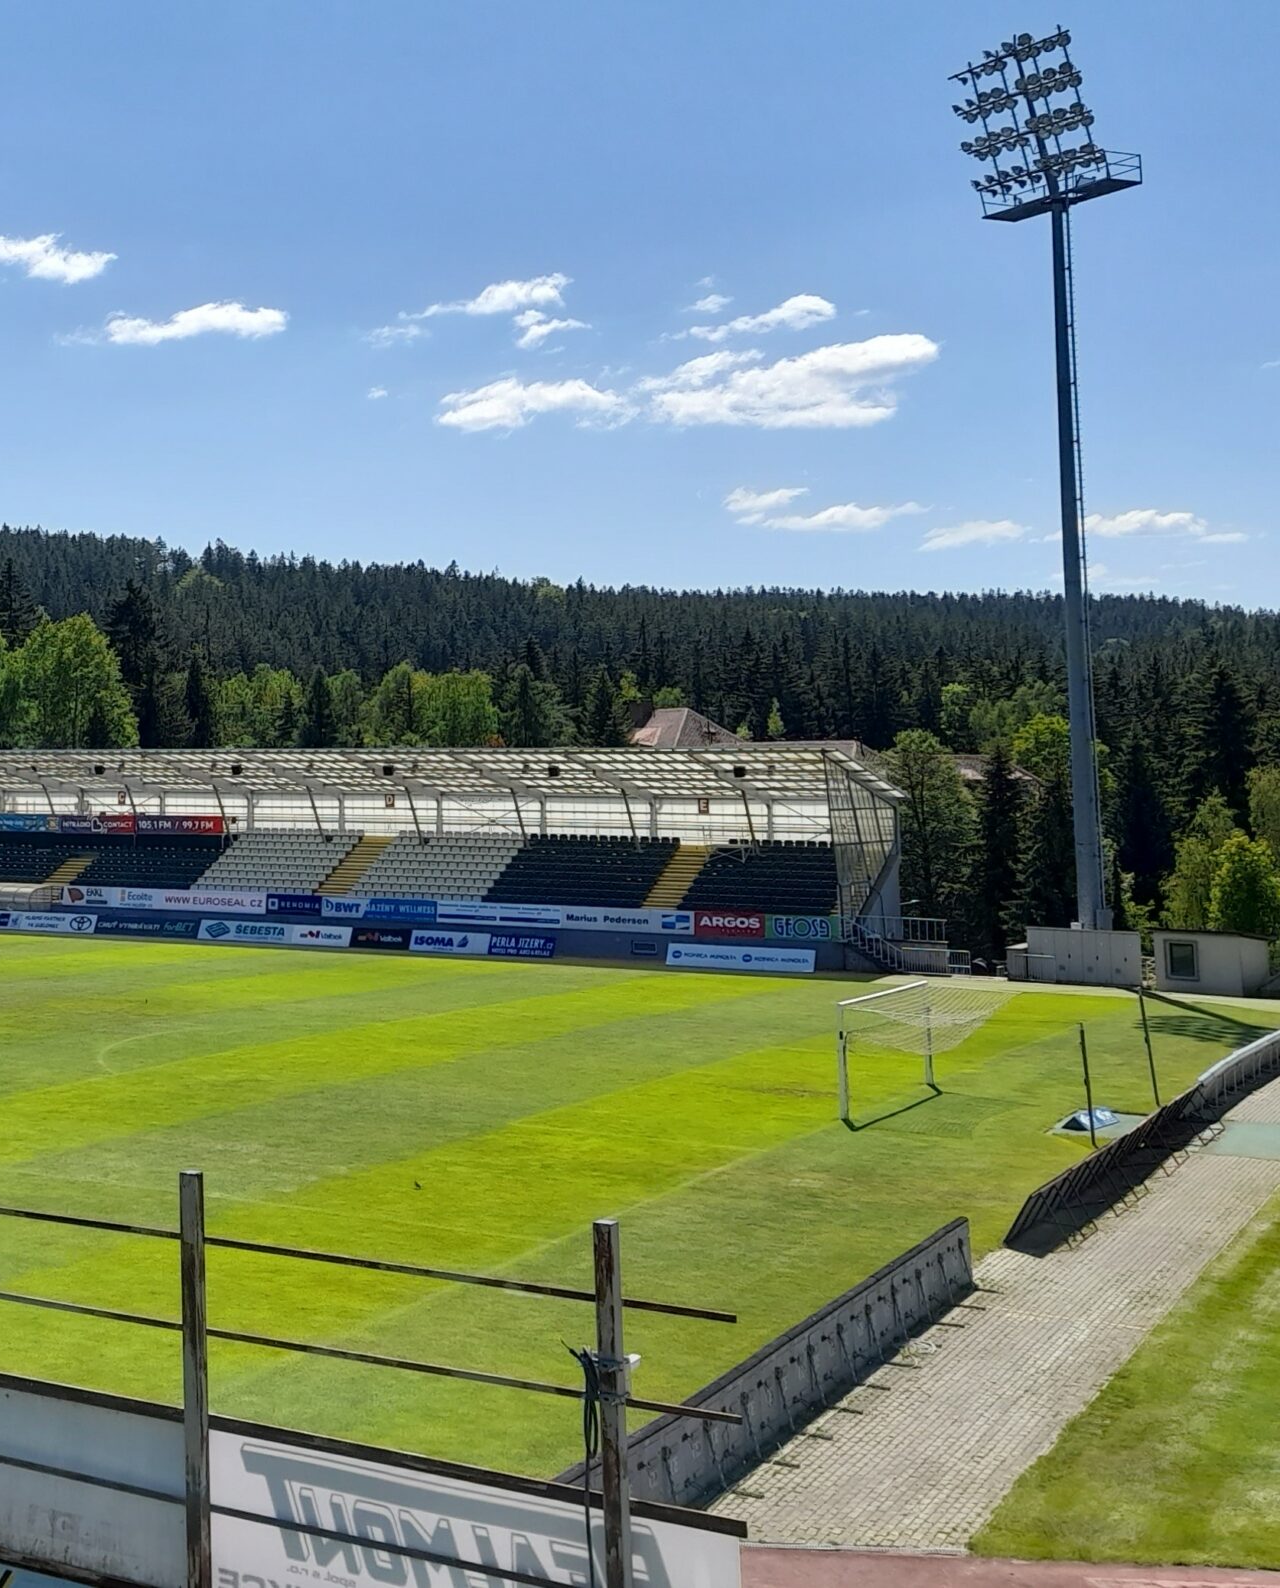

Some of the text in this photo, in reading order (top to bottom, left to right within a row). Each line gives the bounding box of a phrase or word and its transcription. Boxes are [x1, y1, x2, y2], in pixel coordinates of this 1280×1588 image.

[699, 799, 708, 811] E
[159, 821, 171, 829] FM
[200, 821, 213, 829] FM
[281, 901, 320, 909] RENOMIA
[334, 902, 362, 914] BWT
[566, 913, 598, 923] Marius
[603, 915, 649, 925] Pedersen
[699, 916, 761, 928] ARGOS
[235, 924, 285, 937] ŠEBESTA
[414, 935, 454, 947] ISOMA
[491, 936, 516, 948] PERLA
